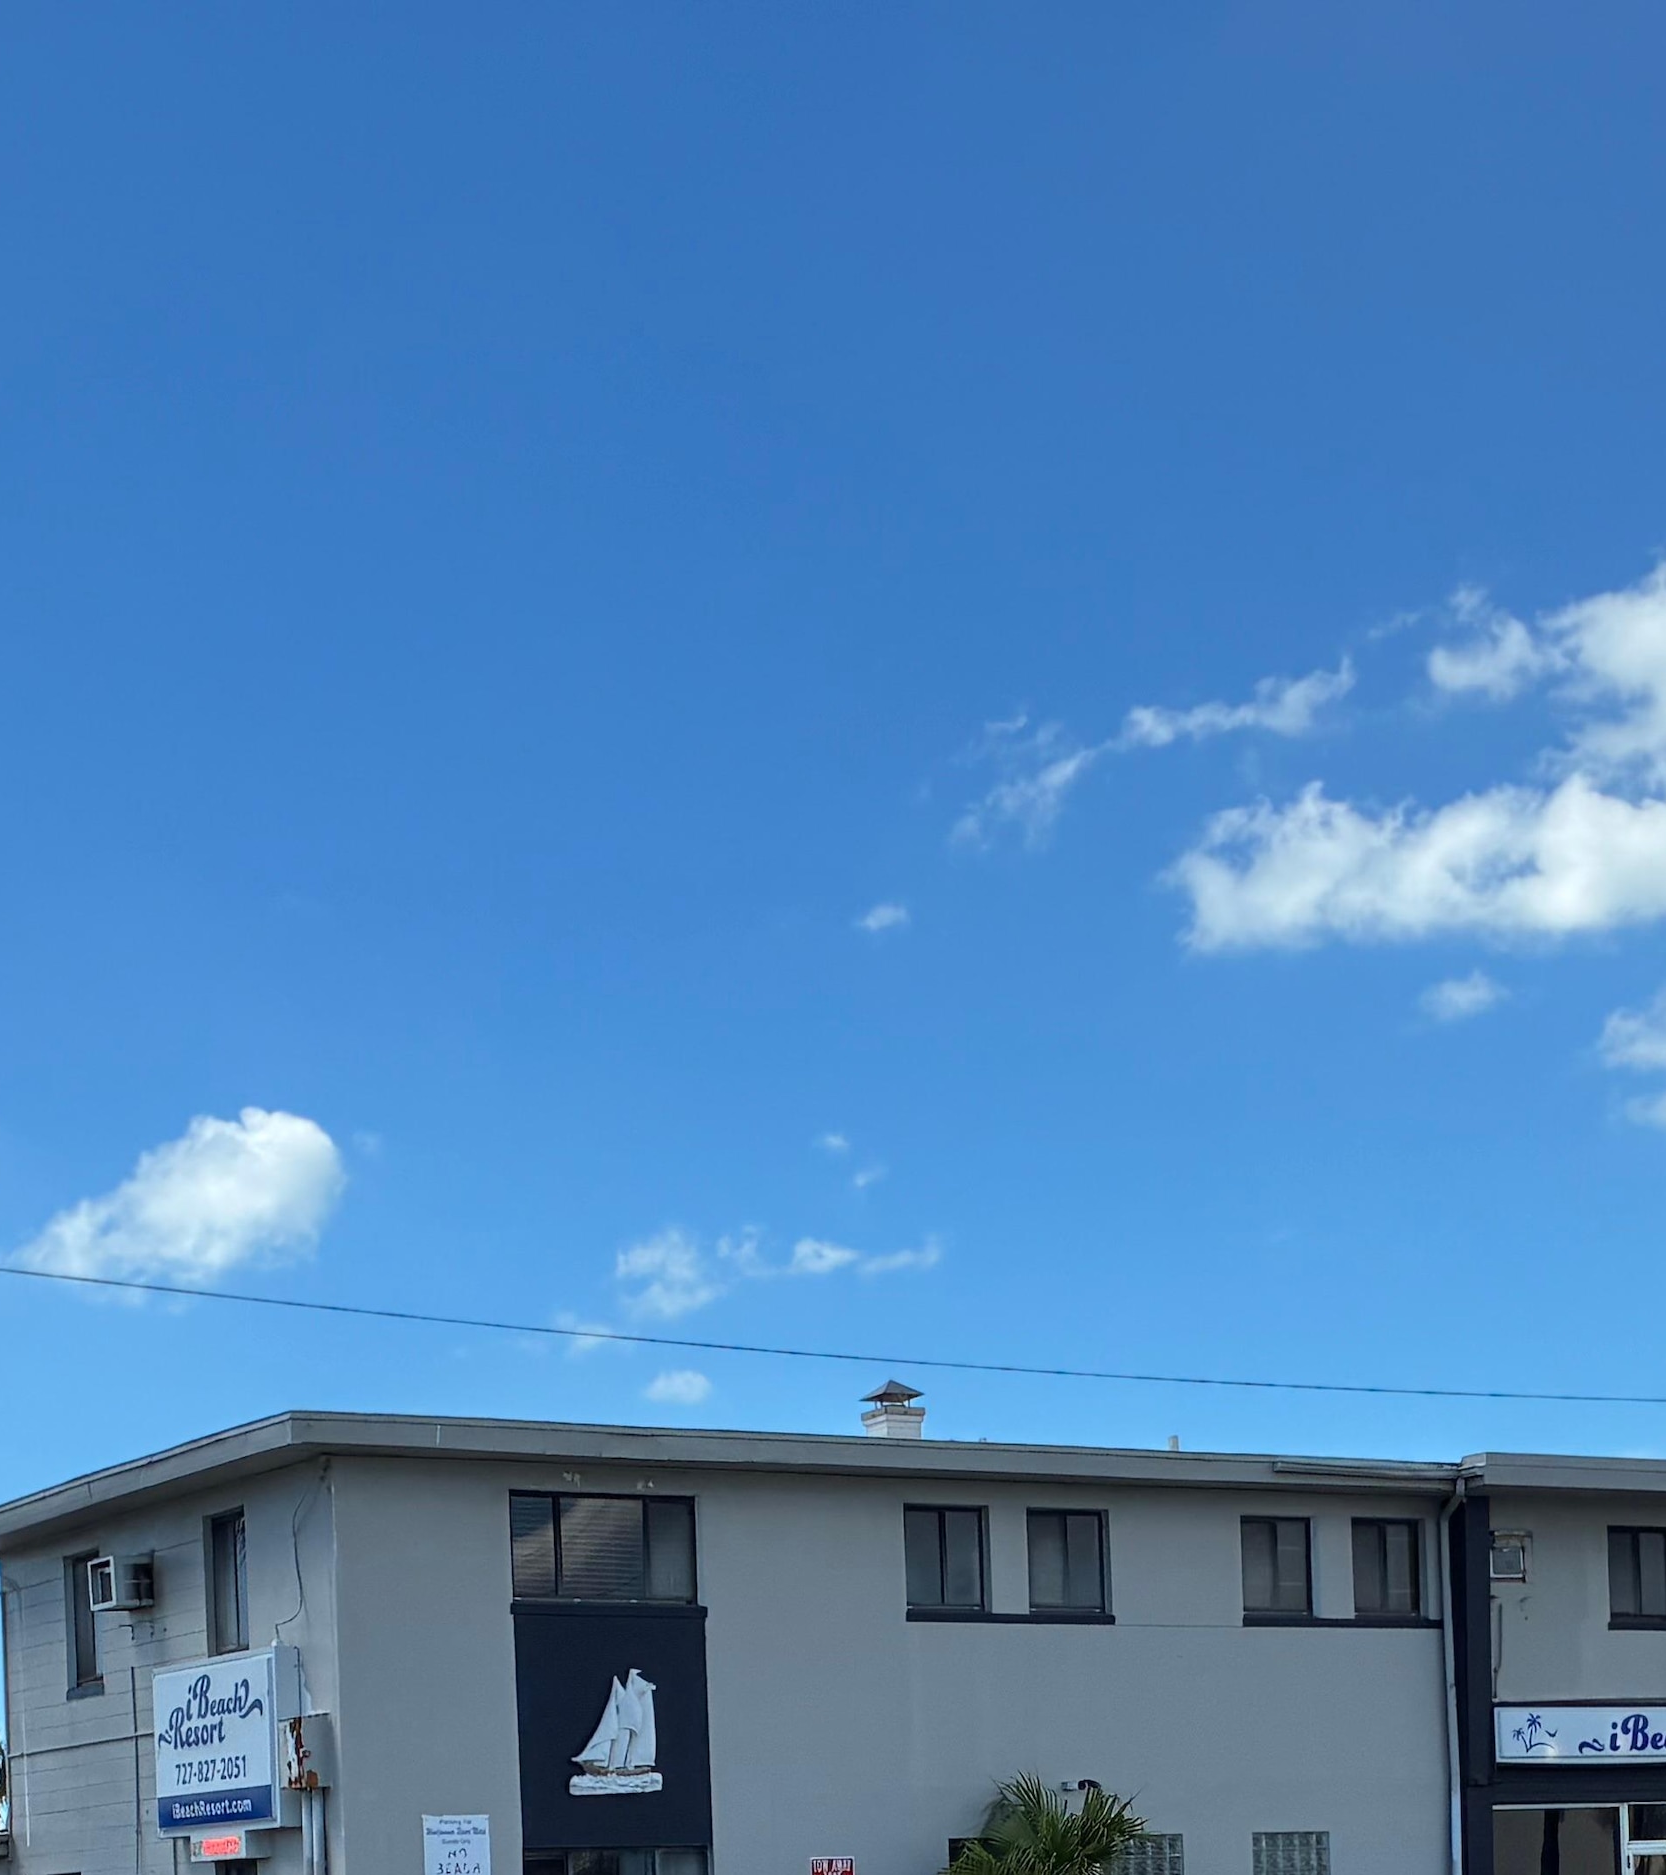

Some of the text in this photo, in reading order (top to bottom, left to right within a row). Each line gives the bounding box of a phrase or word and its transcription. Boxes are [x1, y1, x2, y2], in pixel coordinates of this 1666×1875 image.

[192, 1674, 251, 1719] Beach
[169, 1707, 226, 1750] Resort
[1610, 1722, 1621, 1751] i
[175, 1755, 247, 1786] 727-827-2051
[172, 1798, 252, 1820] iBeachResort.com
